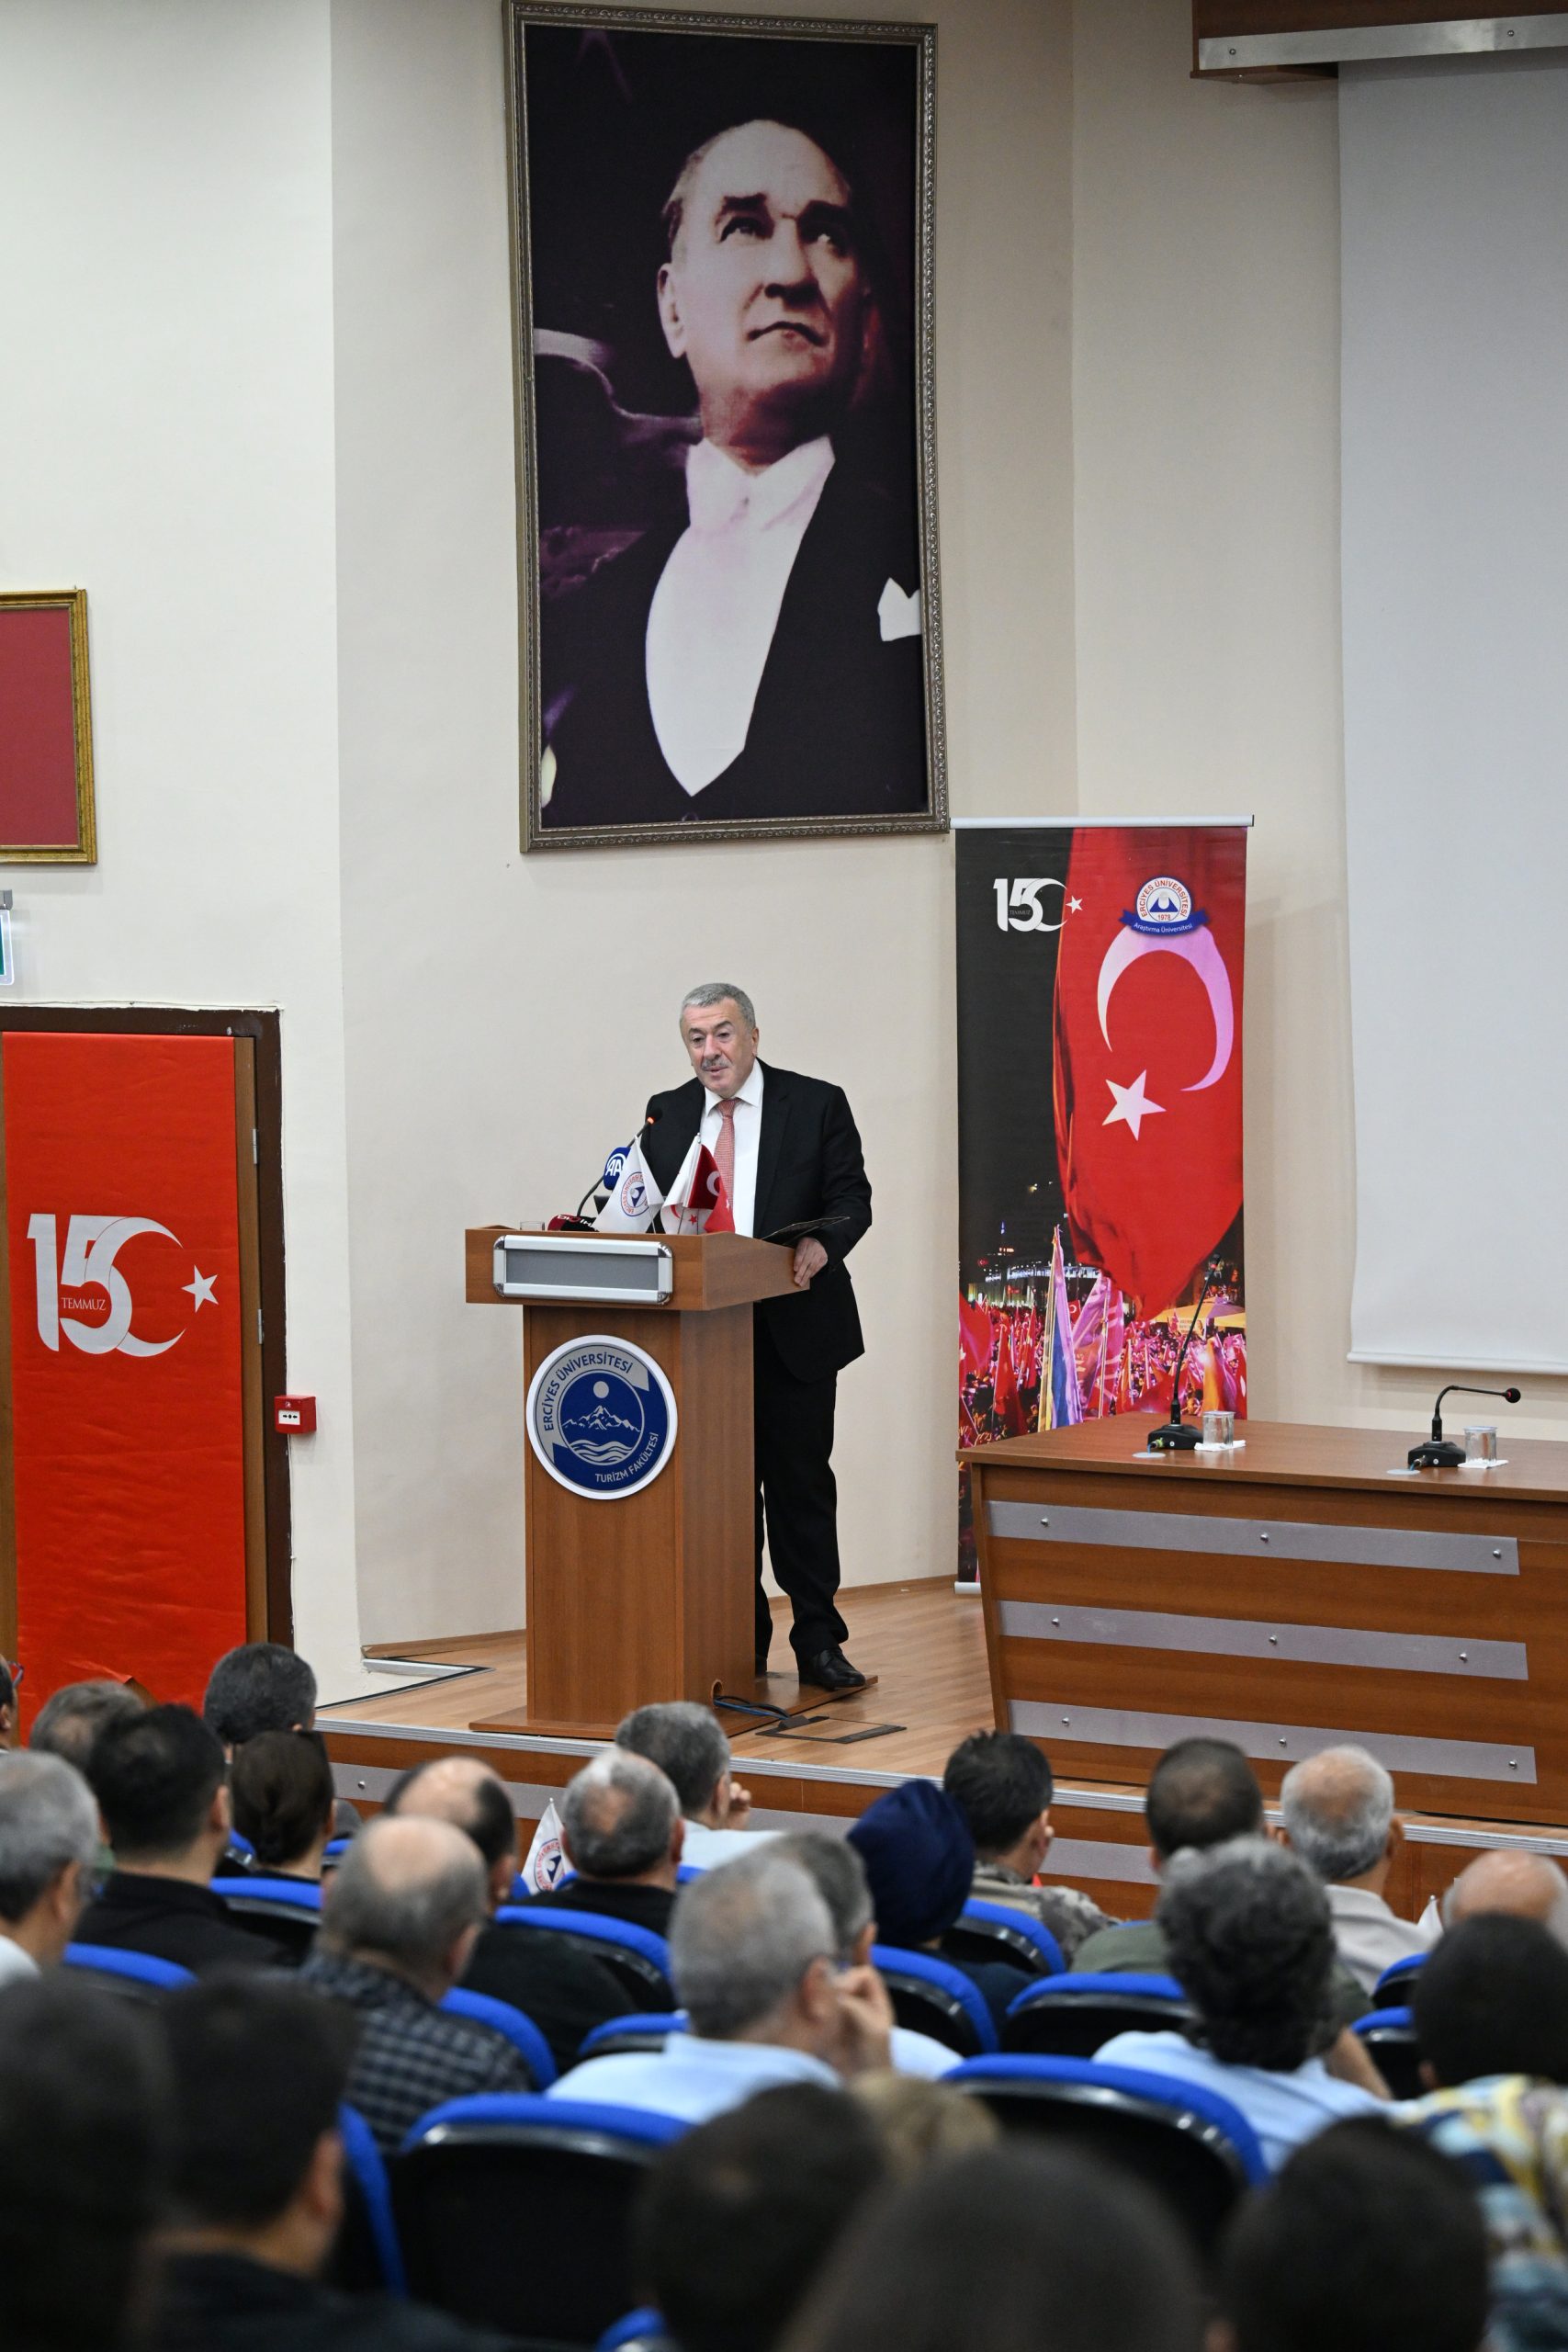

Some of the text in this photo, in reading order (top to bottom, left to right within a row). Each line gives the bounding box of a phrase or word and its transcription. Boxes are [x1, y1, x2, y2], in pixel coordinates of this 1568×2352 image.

[993, 878, 1043, 932] 15
[1139, 884, 1154, 918] ERCİYES
[1160, 922, 1193, 933] Üniversitesi
[604, 1159, 622, 1177] AA
[27, 1213, 133, 1355] 15
[61, 1297, 107, 1311] TEMMUZ
[541, 1351, 634, 1431] ERCİYES ÜNİVERSİTESİ
[594, 1432, 660, 1483] TURİZM FAKÜLTESİ
